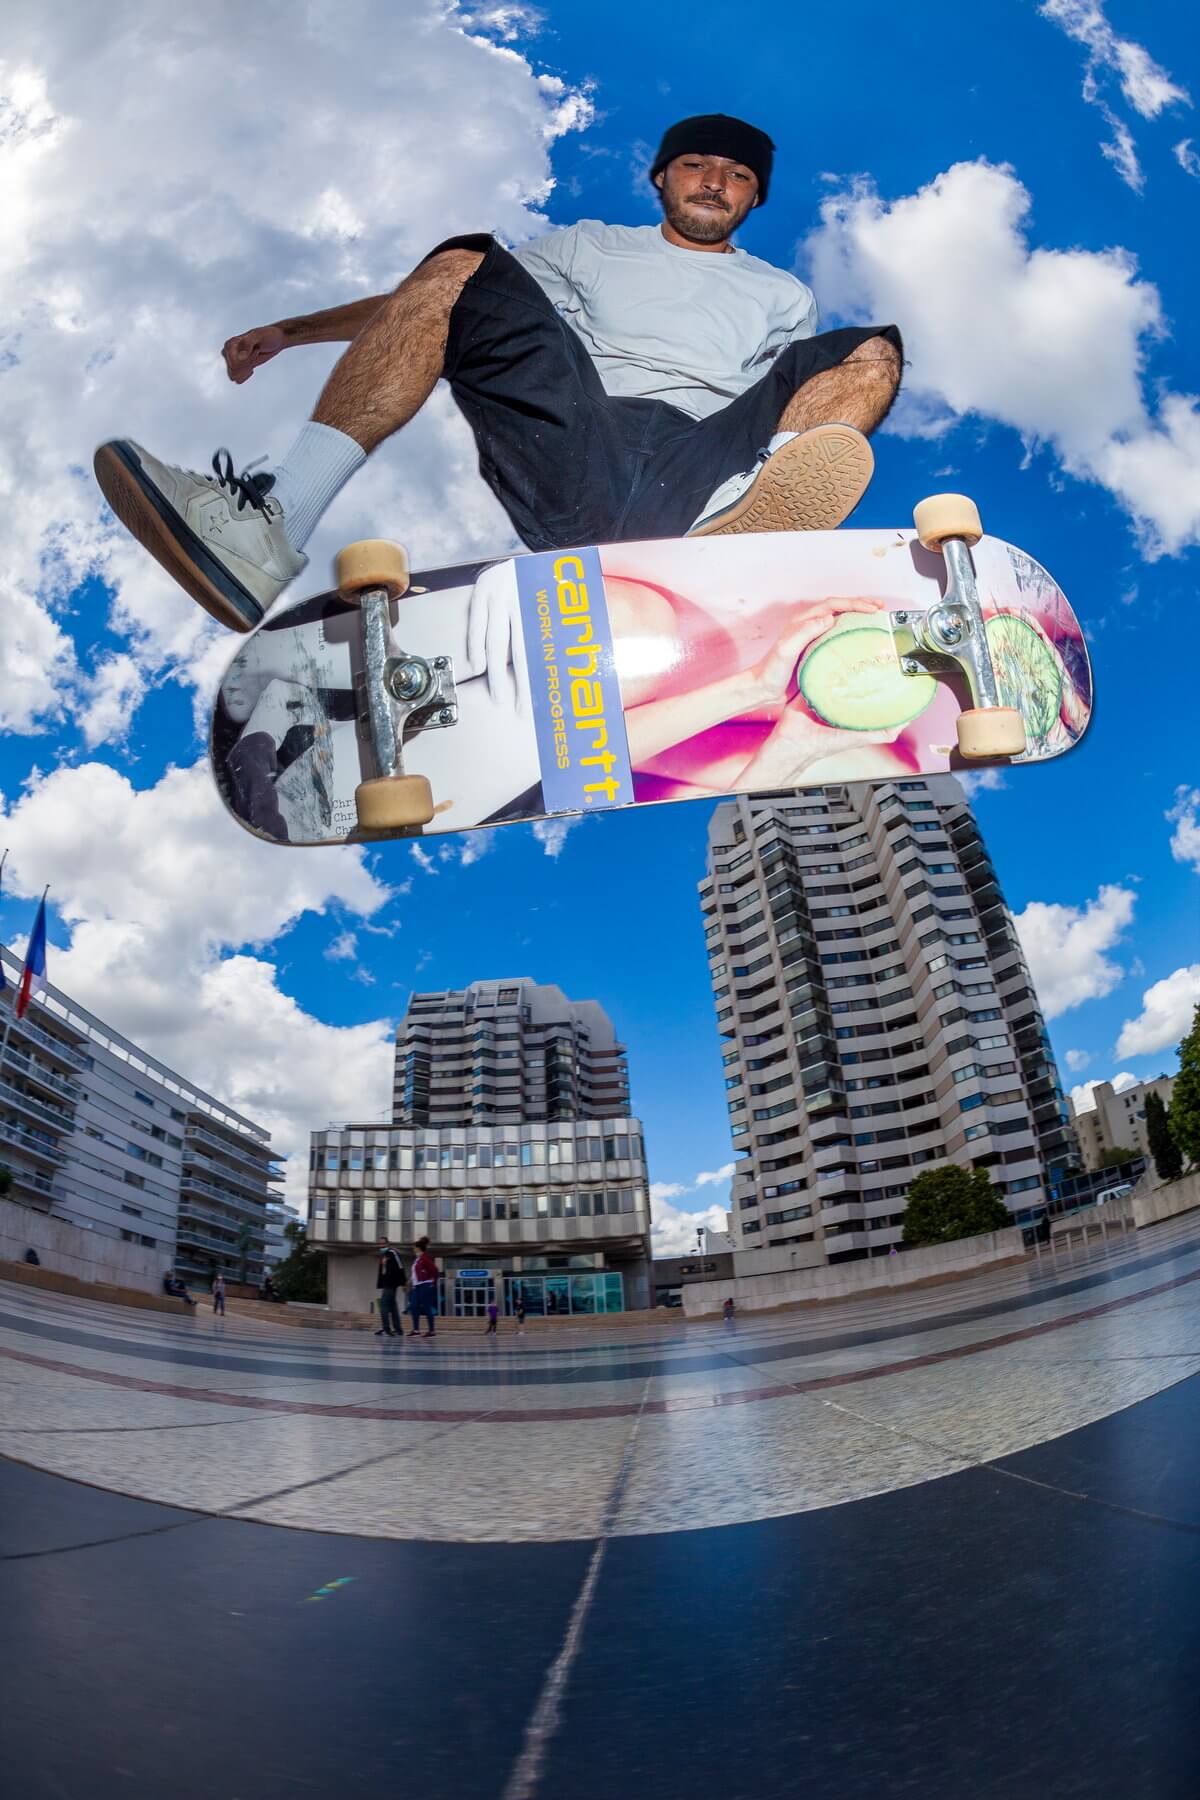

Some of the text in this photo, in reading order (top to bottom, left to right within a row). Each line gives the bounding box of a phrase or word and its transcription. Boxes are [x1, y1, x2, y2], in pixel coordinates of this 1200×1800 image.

[536, 589, 570, 769] WORK IN PROGRESS
[553, 556, 620, 802] carhartt
[332, 799, 354, 809] Chr
[334, 811, 355, 823] Chr
